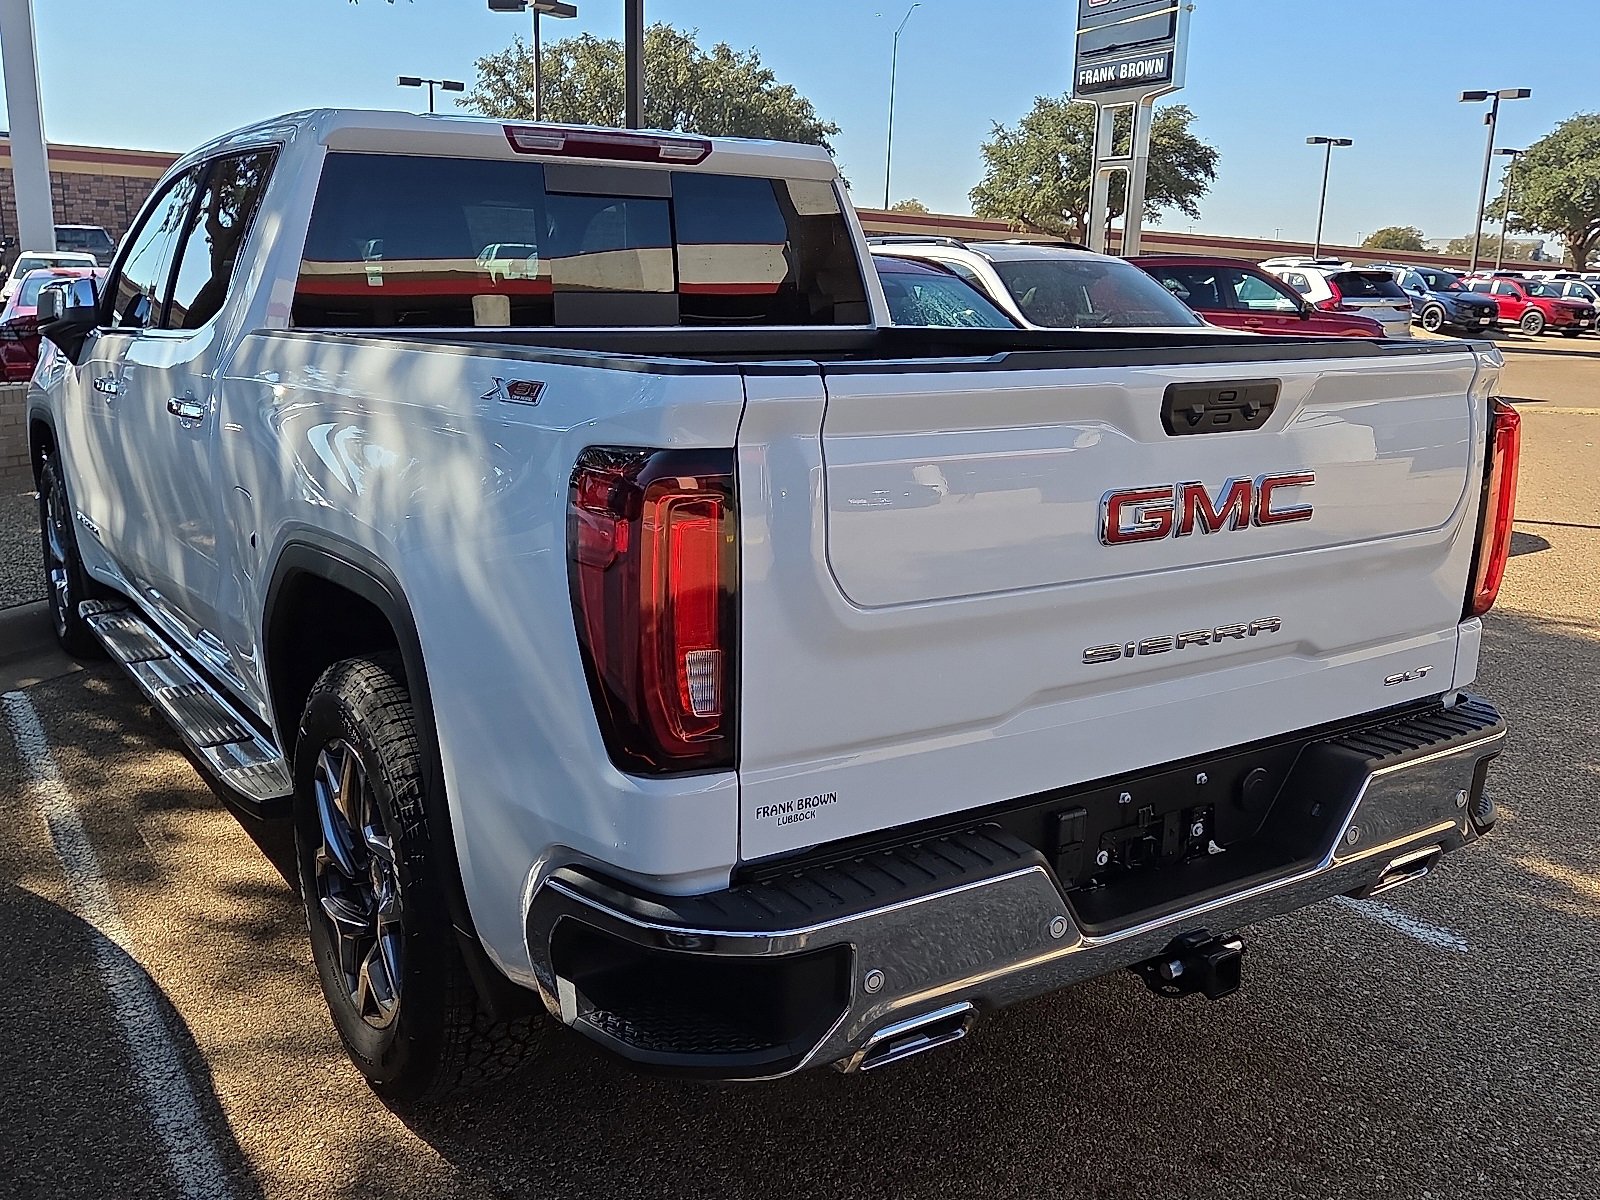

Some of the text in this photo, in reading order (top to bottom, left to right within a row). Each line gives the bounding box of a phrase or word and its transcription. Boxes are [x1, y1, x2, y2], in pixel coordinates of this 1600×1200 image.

[1078, 57, 1165, 86] FRANK BROWN
[1097, 469, 1316, 547] GMC
[1082, 615, 1283, 665] SIERRA
[1383, 664, 1434, 687] SLT
[755, 791, 838, 820] FRANK BROWN
[777, 809, 817, 827] LUBBOCK
